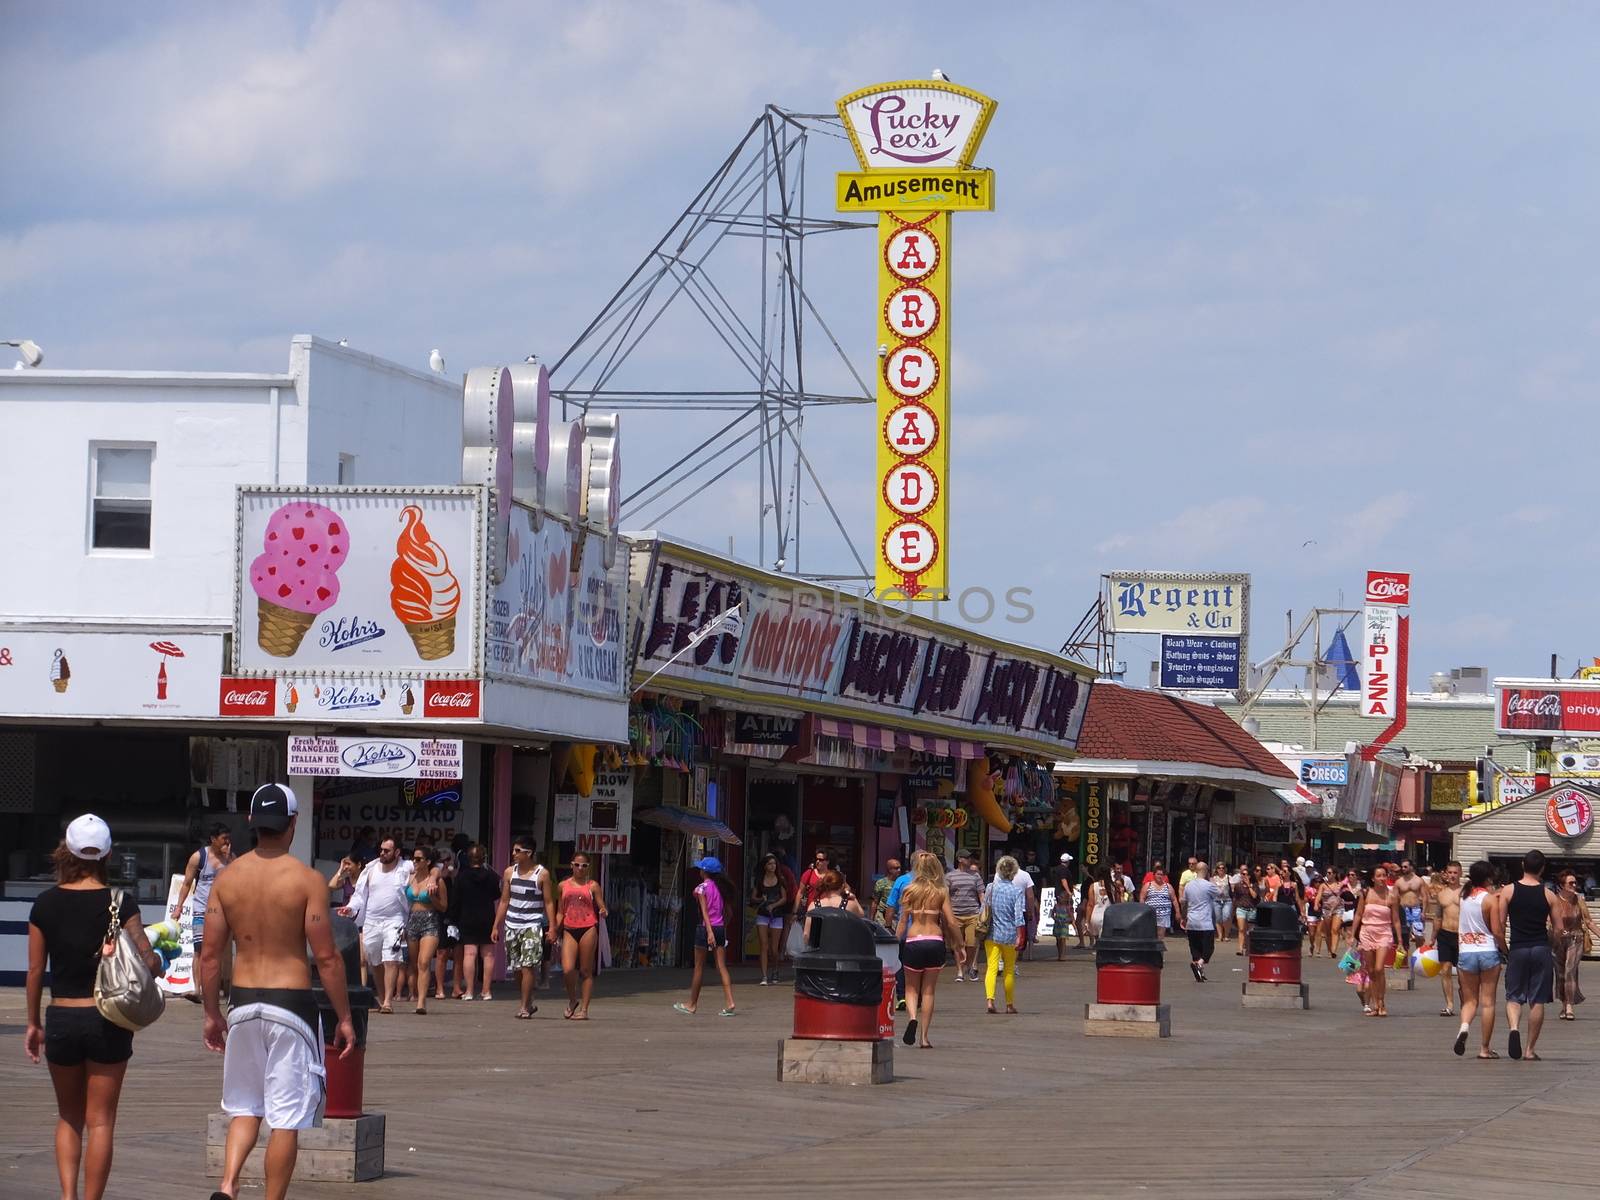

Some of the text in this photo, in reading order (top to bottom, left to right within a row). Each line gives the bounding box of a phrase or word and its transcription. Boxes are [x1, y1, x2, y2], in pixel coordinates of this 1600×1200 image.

[862, 95, 960, 150] Lucky
[845, 177, 979, 202] Amusement
[896, 236, 927, 564] ARCADE
[1368, 579, 1409, 597] Coke
[1118, 582, 1233, 617] Regent
[1187, 610, 1232, 628] & Co
[319, 615, 378, 648] Kohr's
[1369, 645, 1389, 715] PIZZA
[318, 686, 375, 706] Kohr's
[741, 715, 793, 731] ATM
[291, 745, 339, 753] ORANGEADE
[352, 743, 404, 763] Kohr's
[421, 749, 457, 757] CUSTARD
[291, 755, 339, 764] ITALIAN ICE
[417, 759, 460, 768] ICE CREAM
[289, 766, 340, 775] MILKSHAKES
[420, 769, 458, 778] SLUSHIES
[1309, 767, 1346, 782] OREOS
[596, 788, 616, 797] WAS
[359, 804, 456, 822] CUSTARD
[578, 833, 628, 852] MPH
[1086, 832, 1099, 865] BOG
